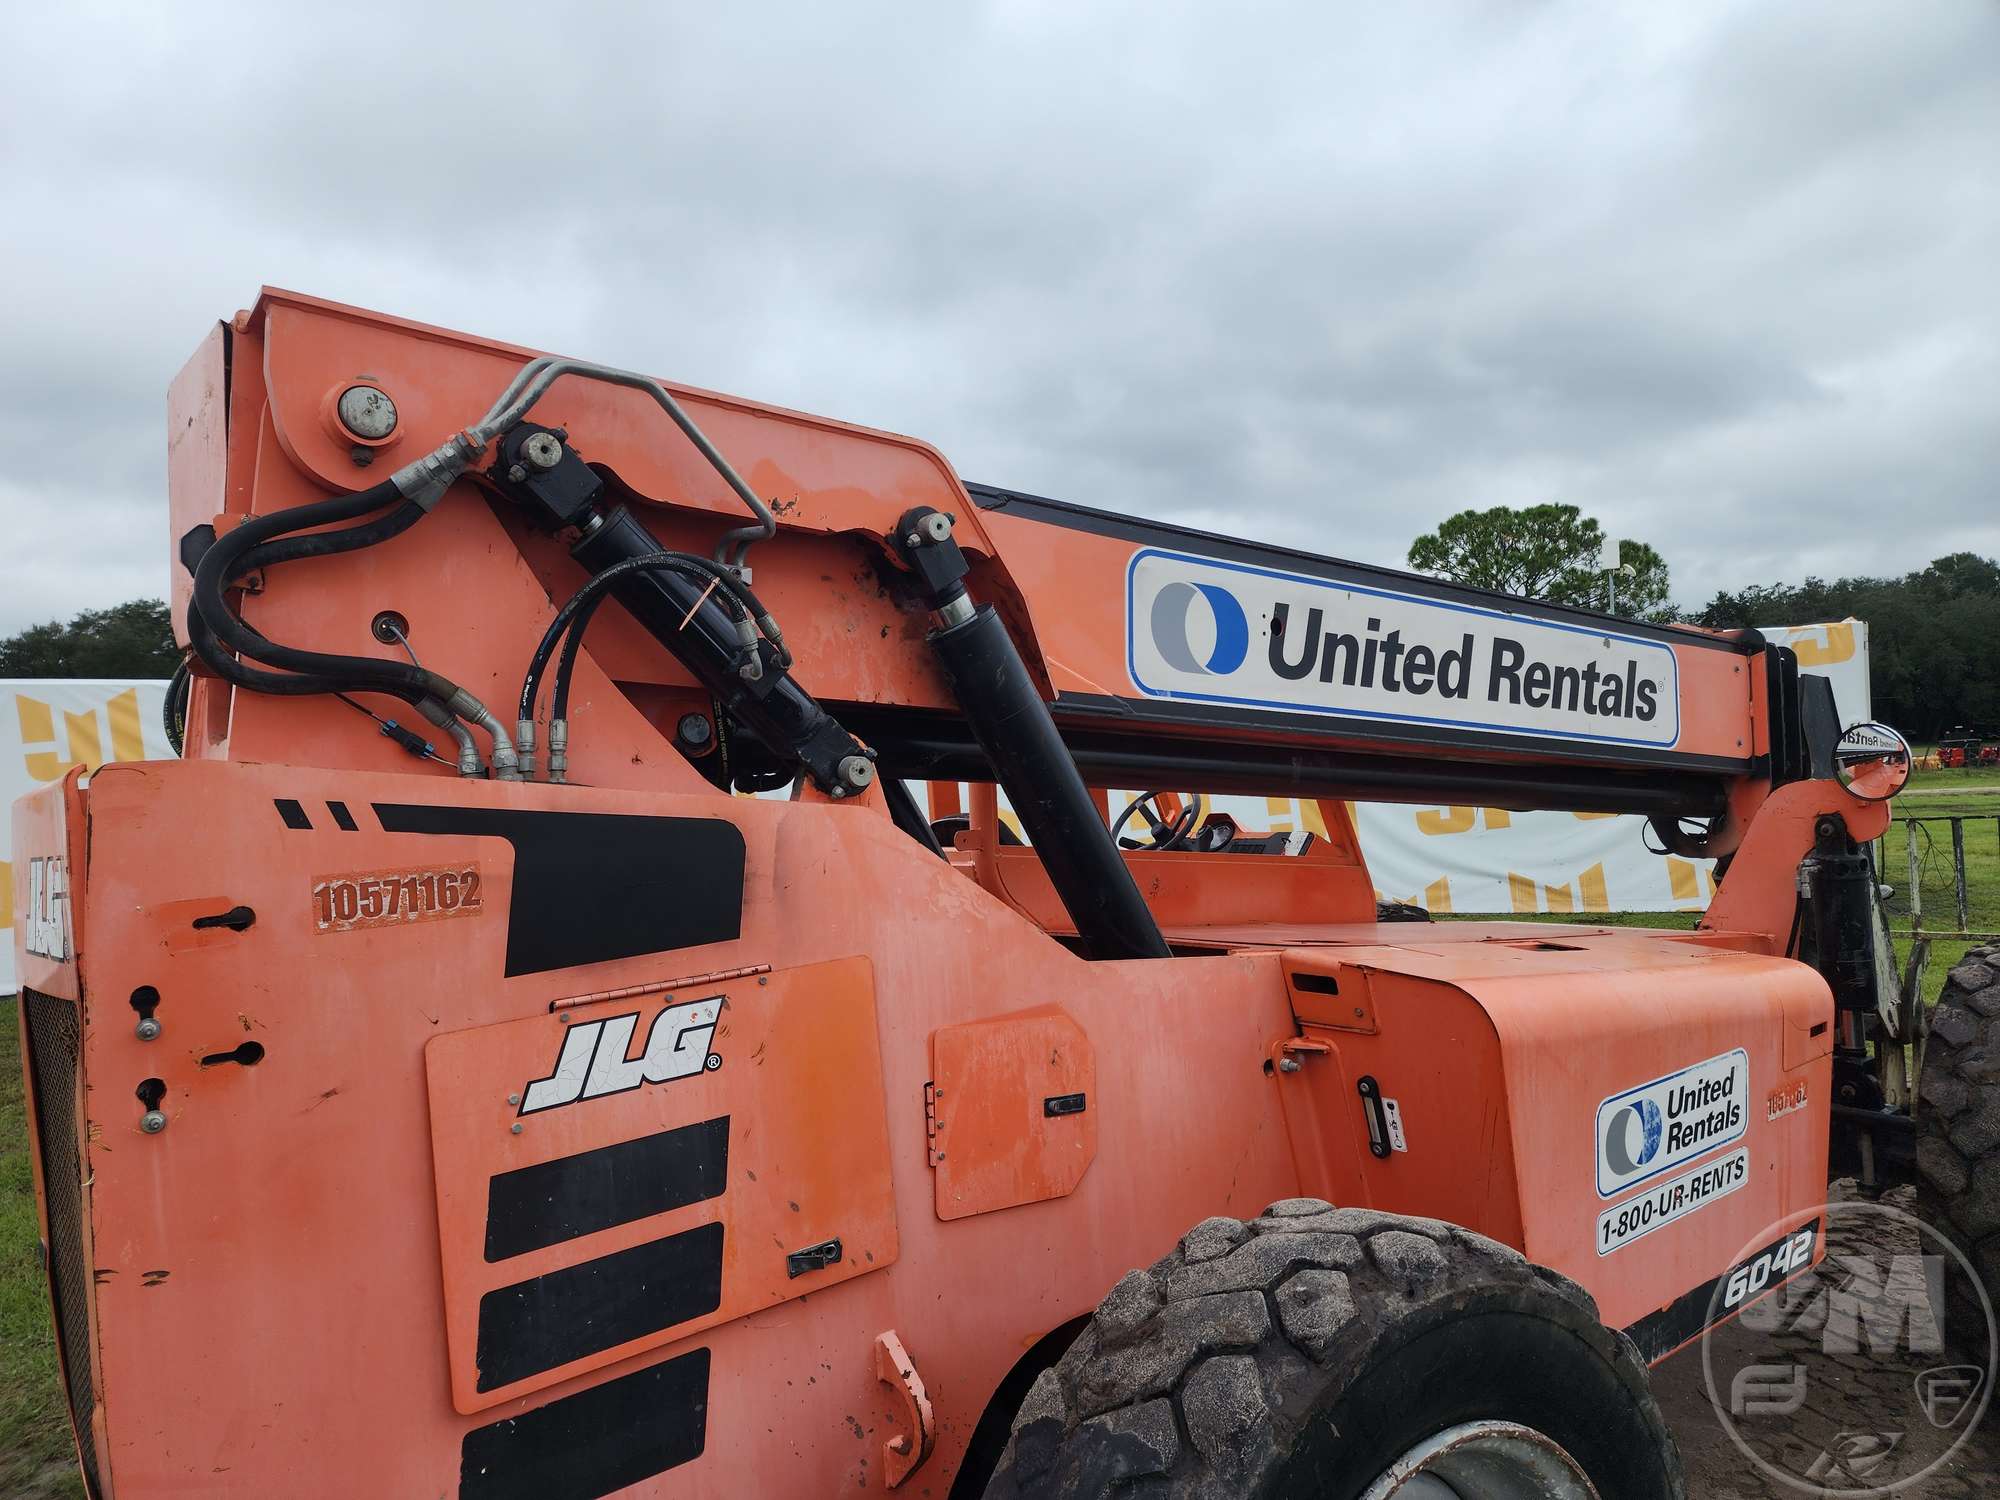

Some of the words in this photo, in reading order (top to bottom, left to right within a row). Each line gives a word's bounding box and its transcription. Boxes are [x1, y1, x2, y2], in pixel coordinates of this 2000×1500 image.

[1267, 601, 1475, 700] United
[1487, 637, 1658, 723] Rentals
[314, 871, 482, 924] 10571162
[516, 994, 726, 1117] JLG
[1667, 1065, 1736, 1121] United
[1666, 1100, 1741, 1155] Rentals
[1602, 1155, 1745, 1245] 1-800-UR-RENTS
[1724, 1230, 1812, 1309] 6042
